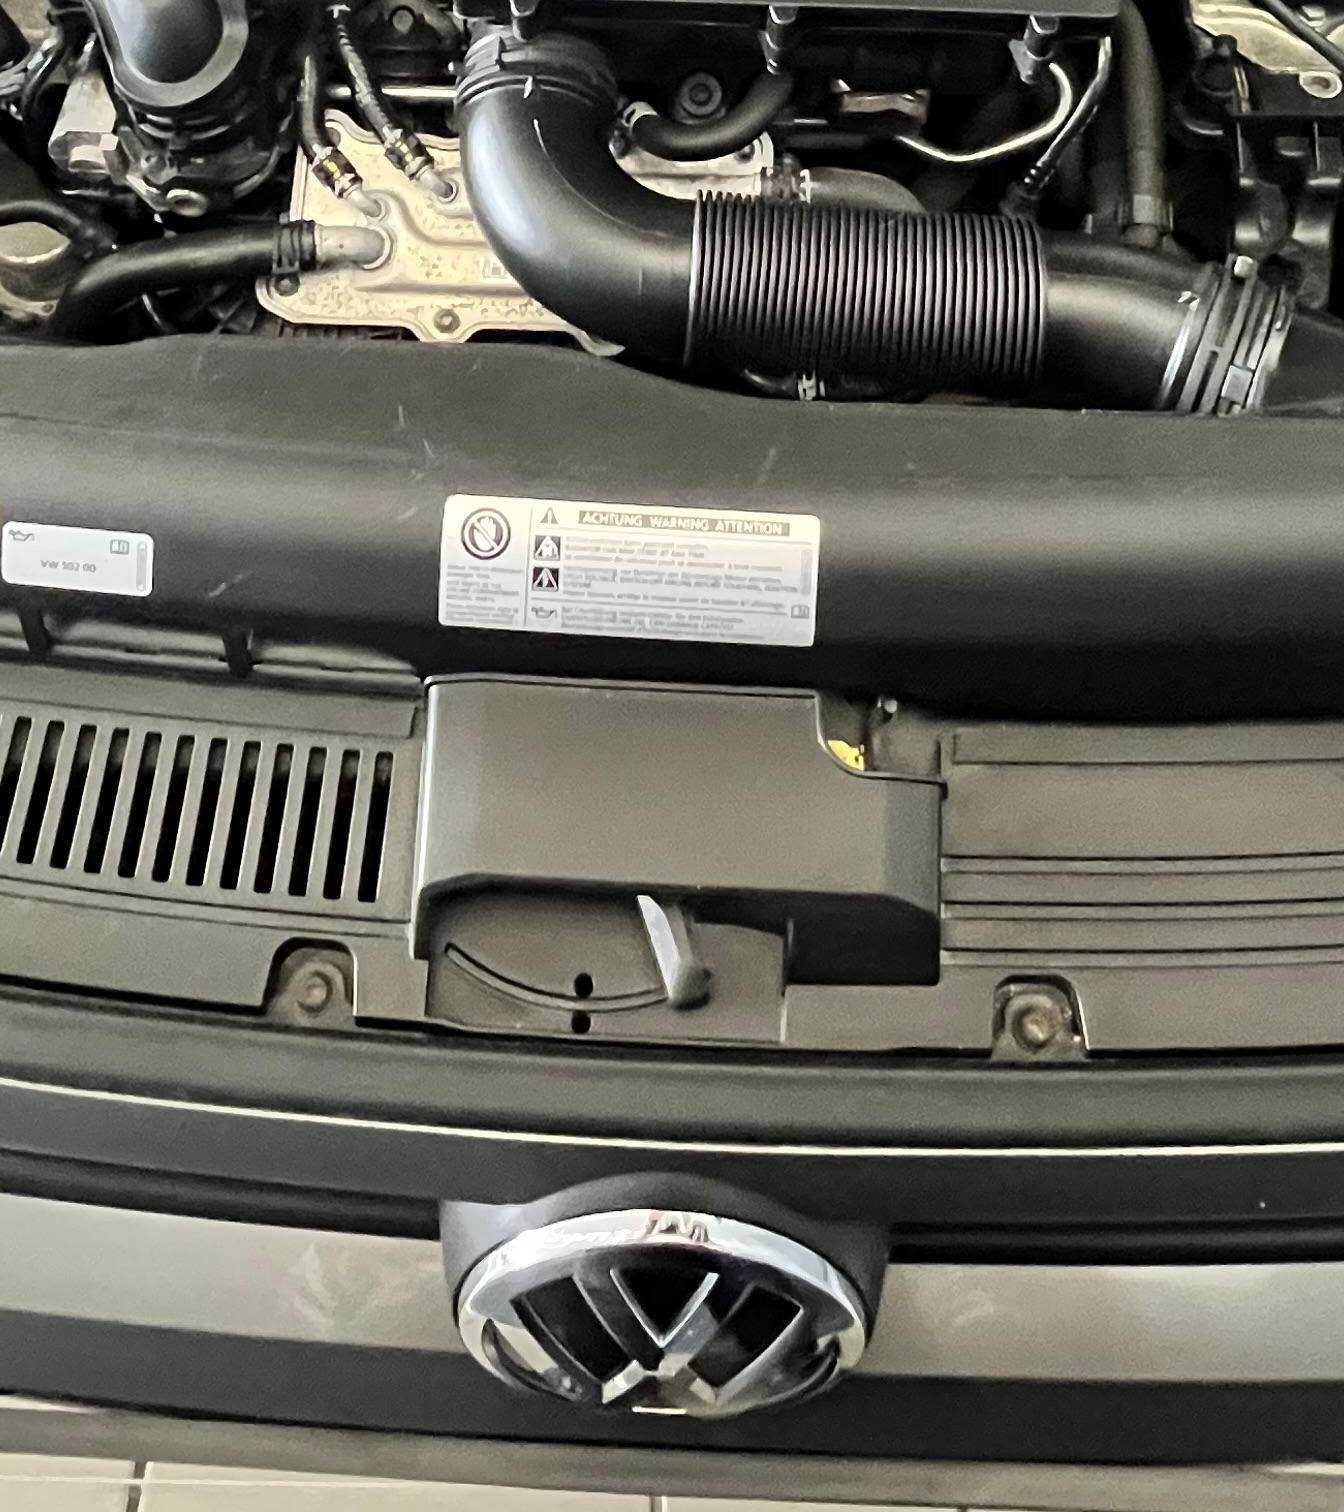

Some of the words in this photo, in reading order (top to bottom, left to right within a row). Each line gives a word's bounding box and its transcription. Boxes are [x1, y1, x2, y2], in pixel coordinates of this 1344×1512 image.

[582, 510, 644, 528] ACHTUNG
[649, 514, 711, 532] WARNING
[714, 519, 783, 536] ATTENTION
